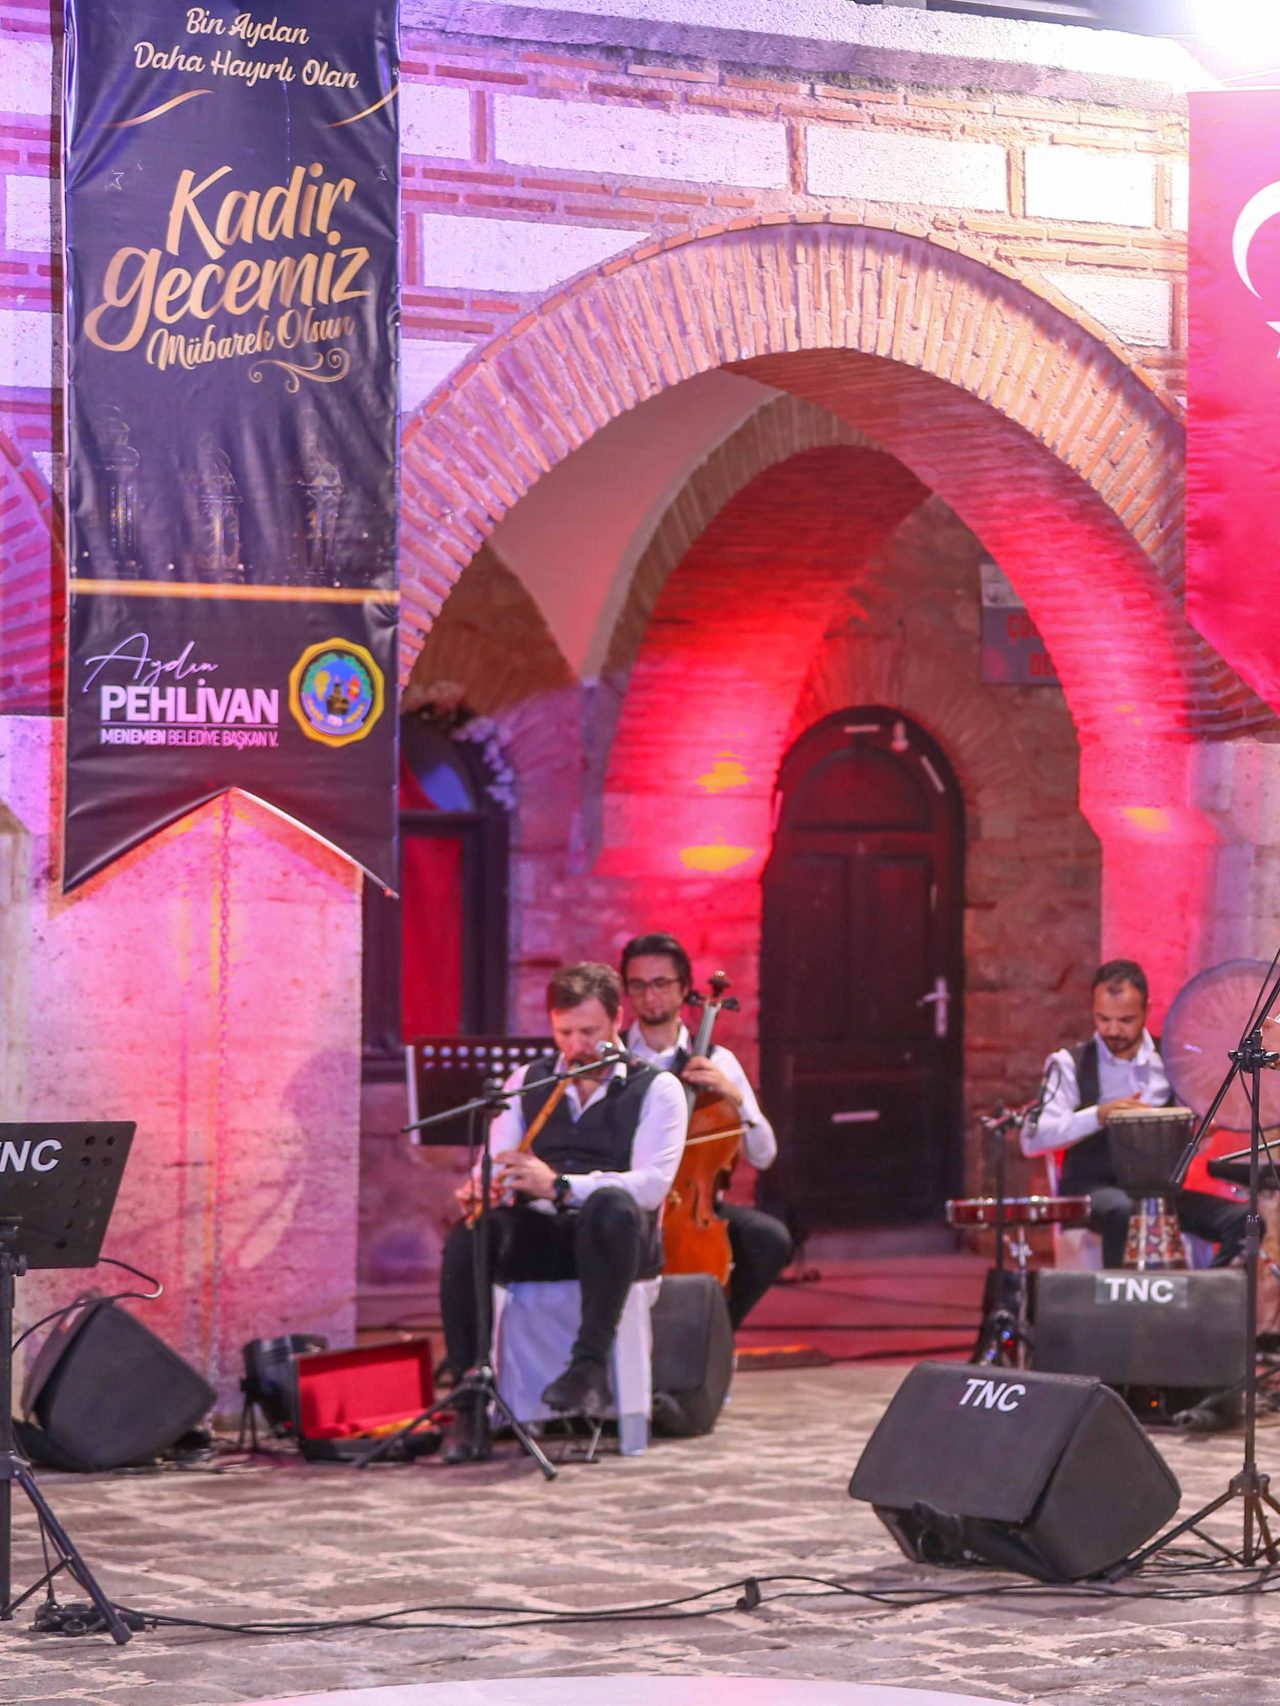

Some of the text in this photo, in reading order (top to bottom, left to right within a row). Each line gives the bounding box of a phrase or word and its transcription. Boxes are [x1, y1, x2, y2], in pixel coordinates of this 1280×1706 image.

[186, 7, 310, 49] Bin Aydan
[134, 41, 359, 90] Daha Hayırlı Olan
[166, 162, 357, 260] Kadir
[84, 230, 371, 352] gecemiz
[146, 307, 356, 371] Mübarek Olsun
[1008, 613, 1040, 646] ÇO
[82, 632, 219, 694] Aydın
[101, 678, 279, 724] PEHLİVAN
[101, 726, 279, 750] MENEMEN BELEDİYE BAŞKAN V.
[0, 1139, 63, 1172] NC
[1104, 1277, 1174, 1303] TNC
[959, 1378, 1026, 1412] TNC
